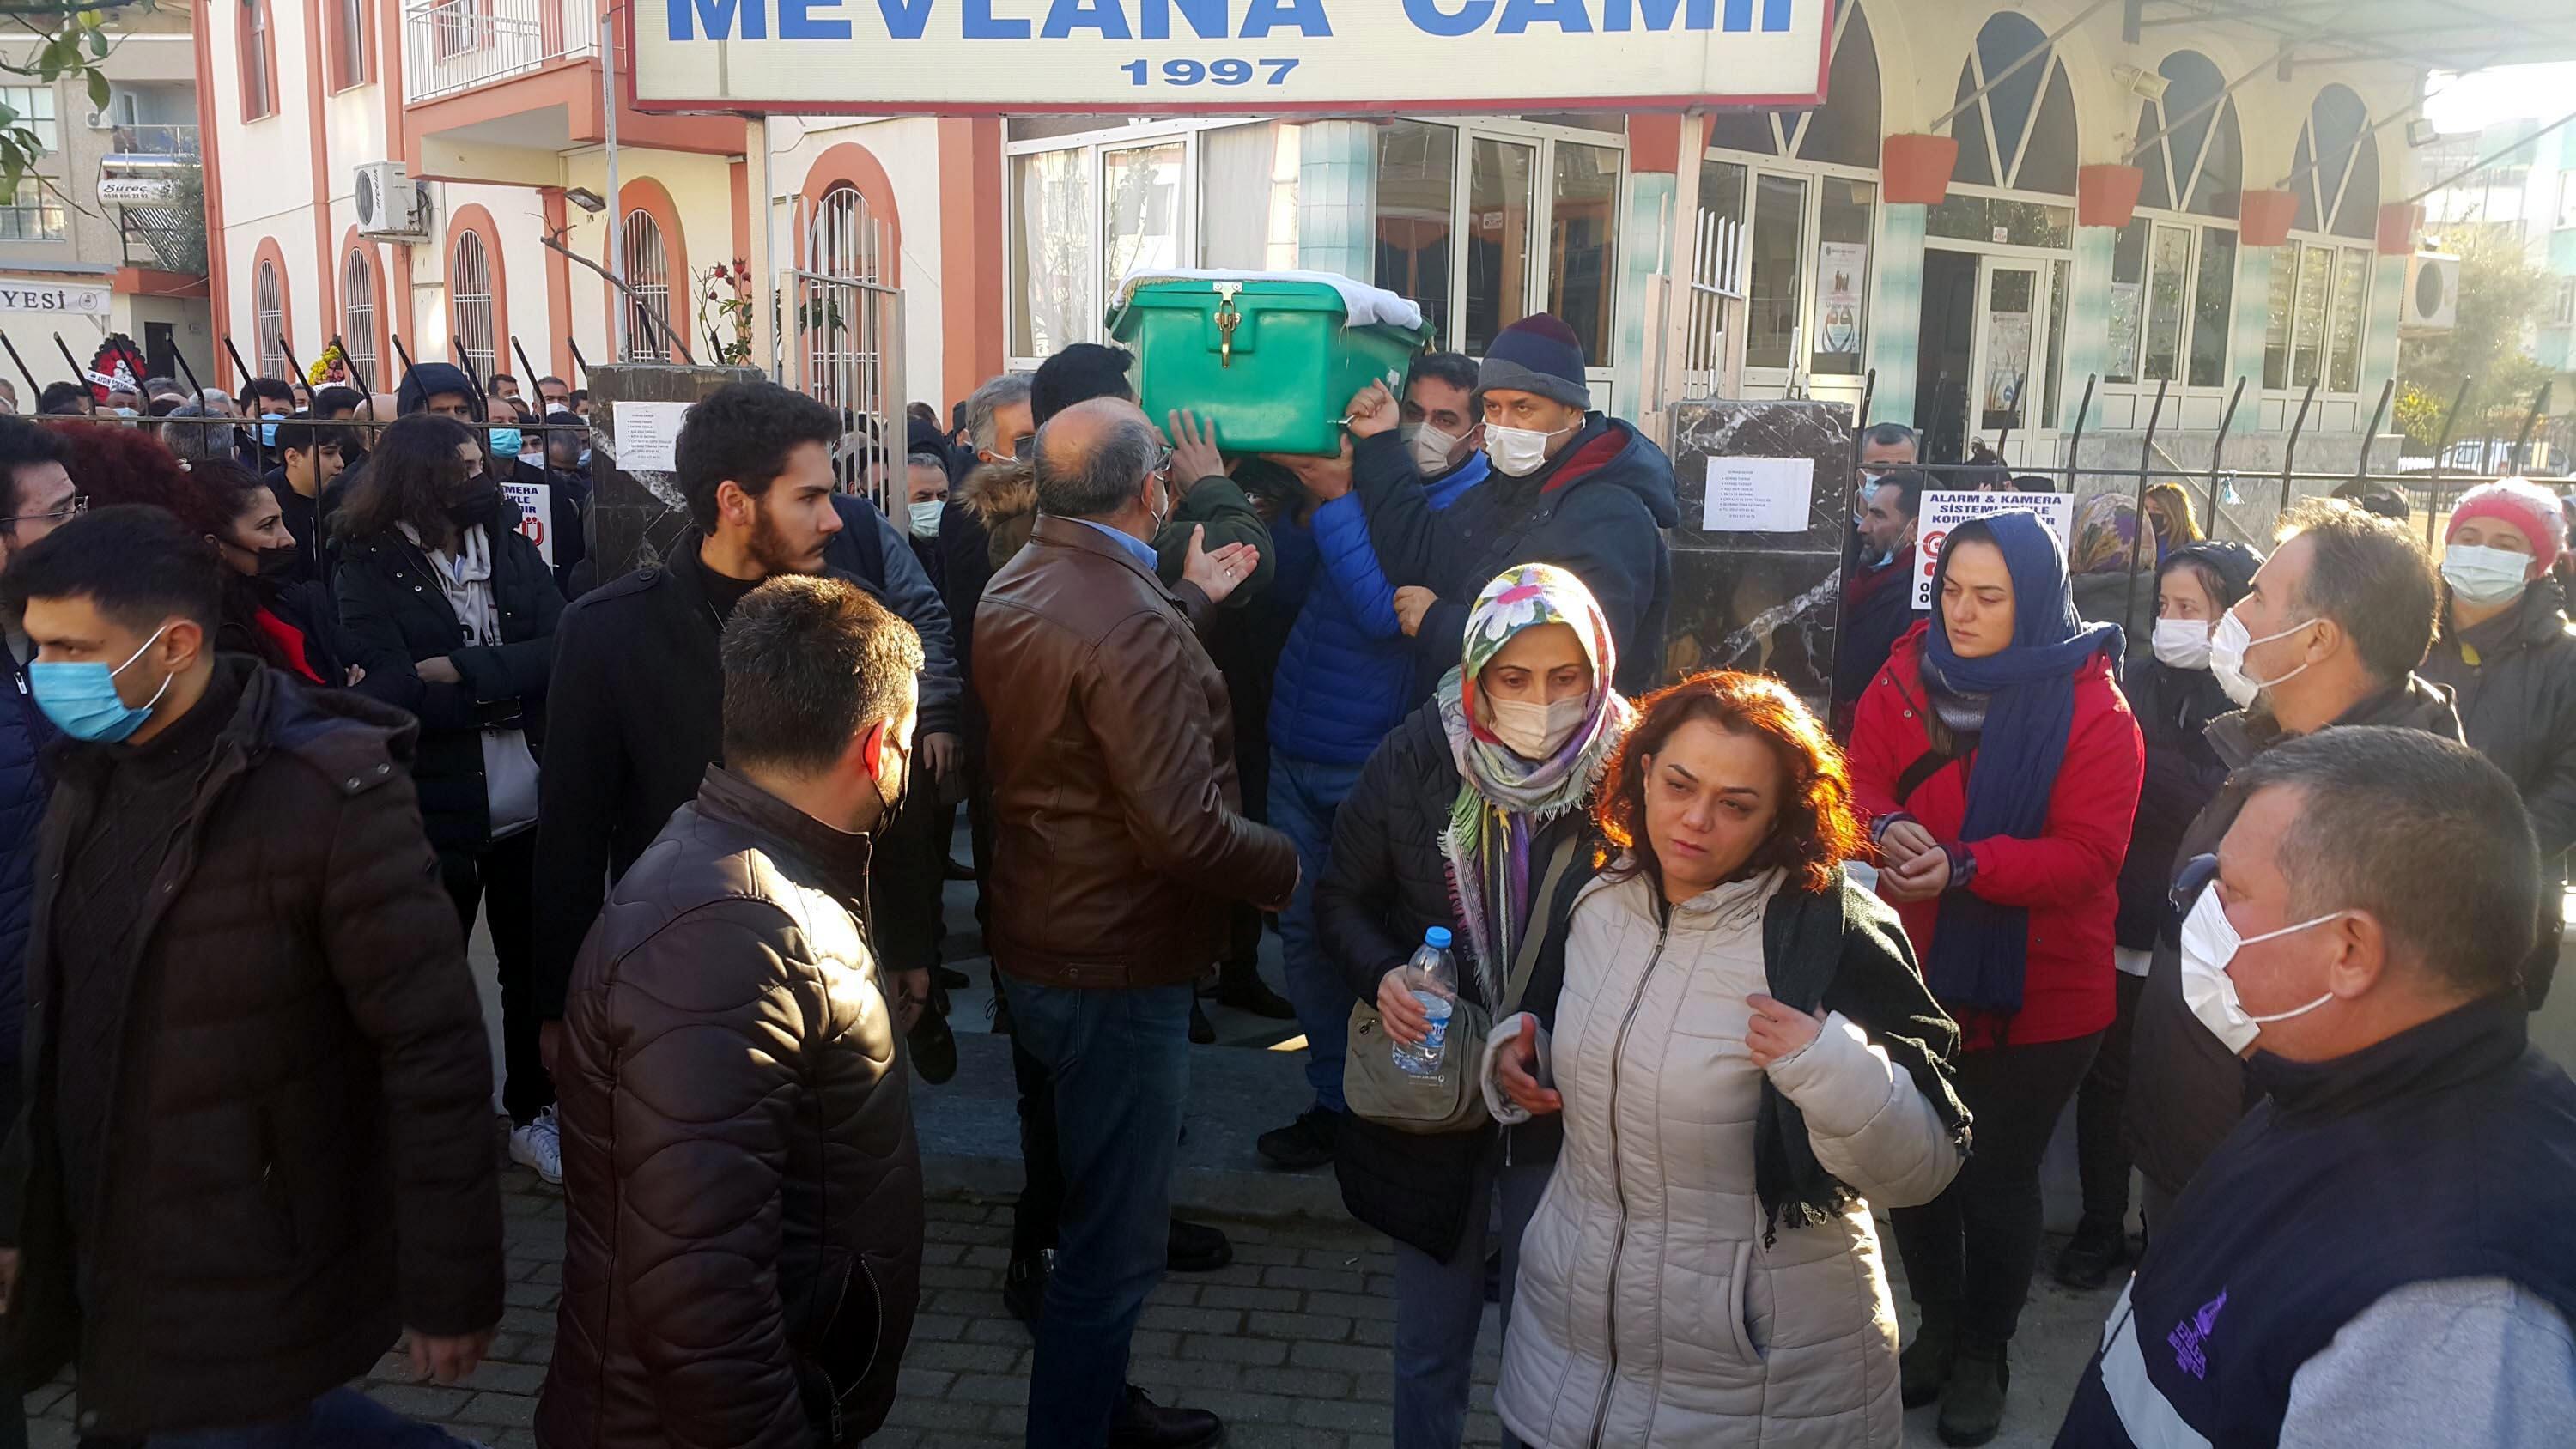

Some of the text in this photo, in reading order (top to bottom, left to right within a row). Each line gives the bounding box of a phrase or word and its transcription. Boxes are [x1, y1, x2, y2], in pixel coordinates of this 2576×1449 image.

[1121, 58, 1299, 85] 1997
[1, 289, 65, 310] YESİ
[1930, 494, 2062, 505] ALARM & KAMERA
